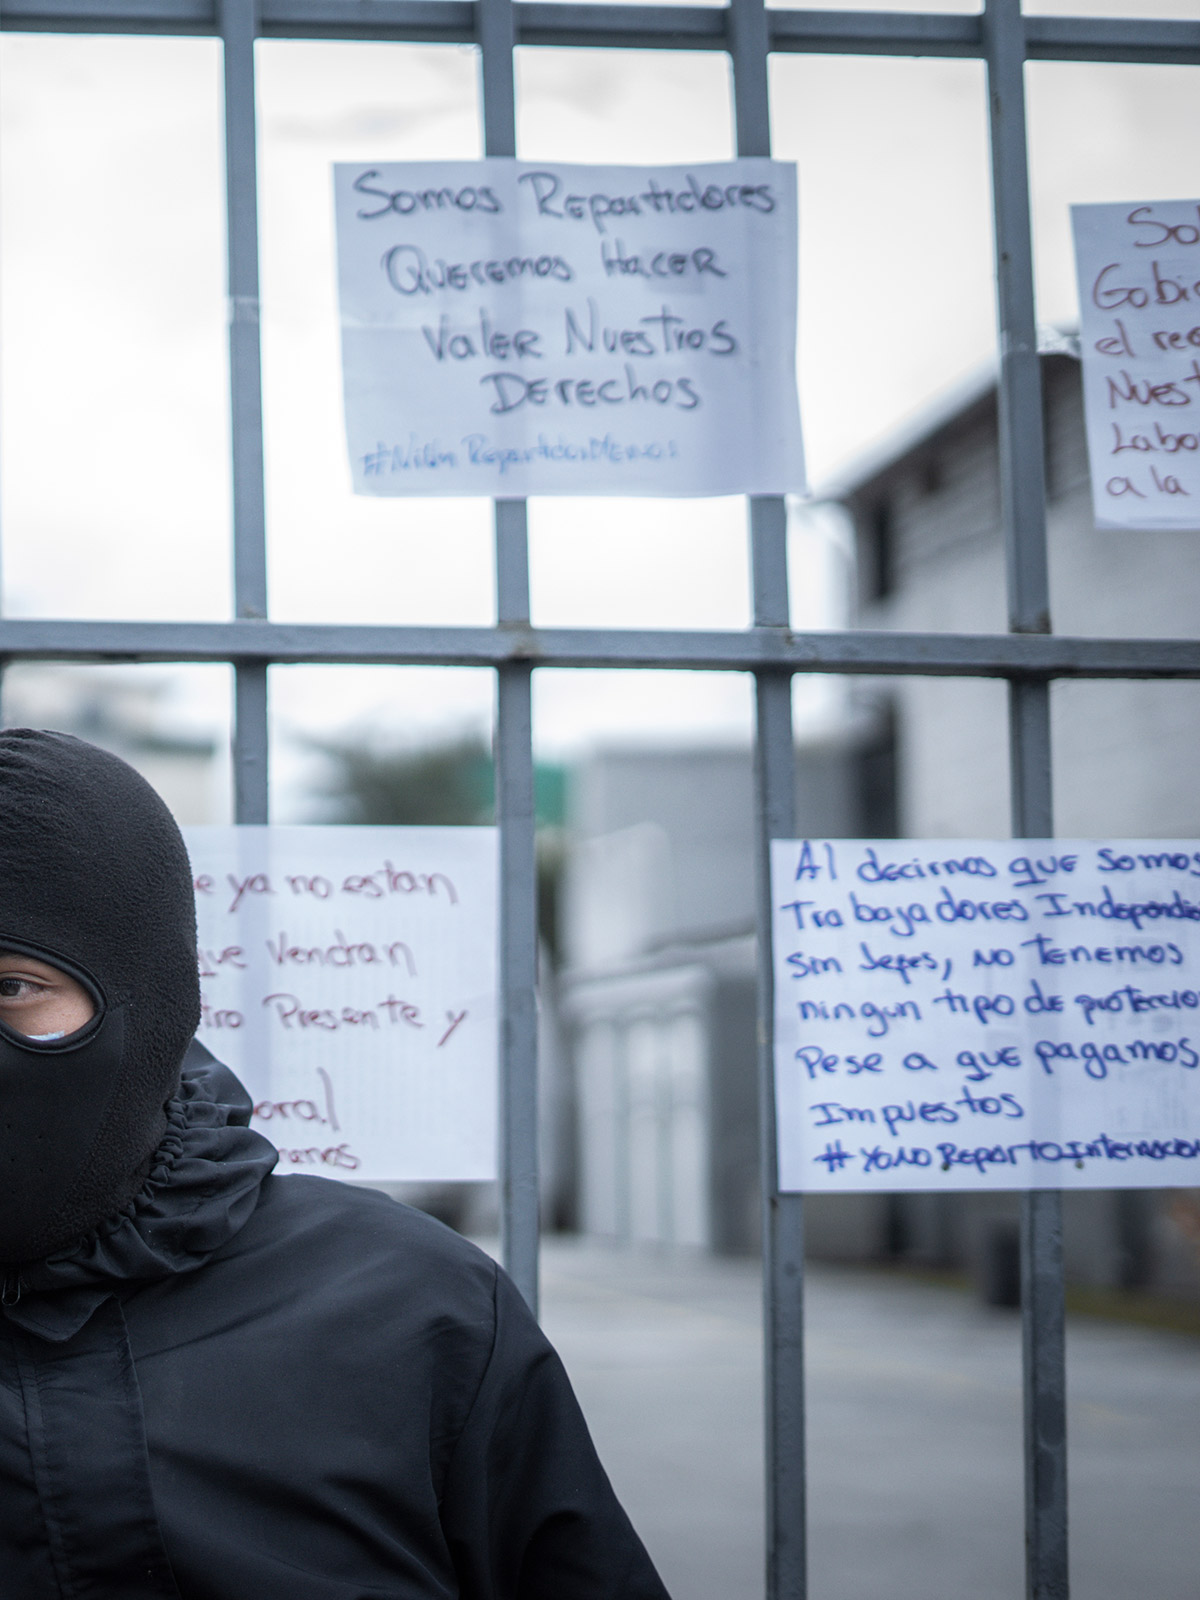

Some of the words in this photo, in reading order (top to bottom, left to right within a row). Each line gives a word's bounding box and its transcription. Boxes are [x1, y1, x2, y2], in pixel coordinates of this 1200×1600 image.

[352, 169, 502, 221] Somos
[517, 170, 777, 235] Repartidores
[1127, 206, 1200, 248] So
[1095, 318, 1135, 358] el
[1111, 422, 1200, 455] Labo
[794, 840, 839, 882] Al
[855, 847, 999, 883] decirnos
[227, 873, 275, 914] ya
[285, 873, 333, 899] no
[341, 859, 459, 905] estan
[779, 886, 1031, 937] Trabajadores
[200, 990, 244, 1029] tro
[261, 992, 427, 1031] Presente
[798, 1000, 923, 1037] ningun
[932, 987, 1016, 1025] tipo
[1073, 984, 1200, 1026] proteccio
[902, 1051, 939, 1070] a
[1033, 1037, 1200, 1080] pagamos
[253, 1066, 341, 1132] oral
[808, 1084, 1026, 1137] Impuestos
